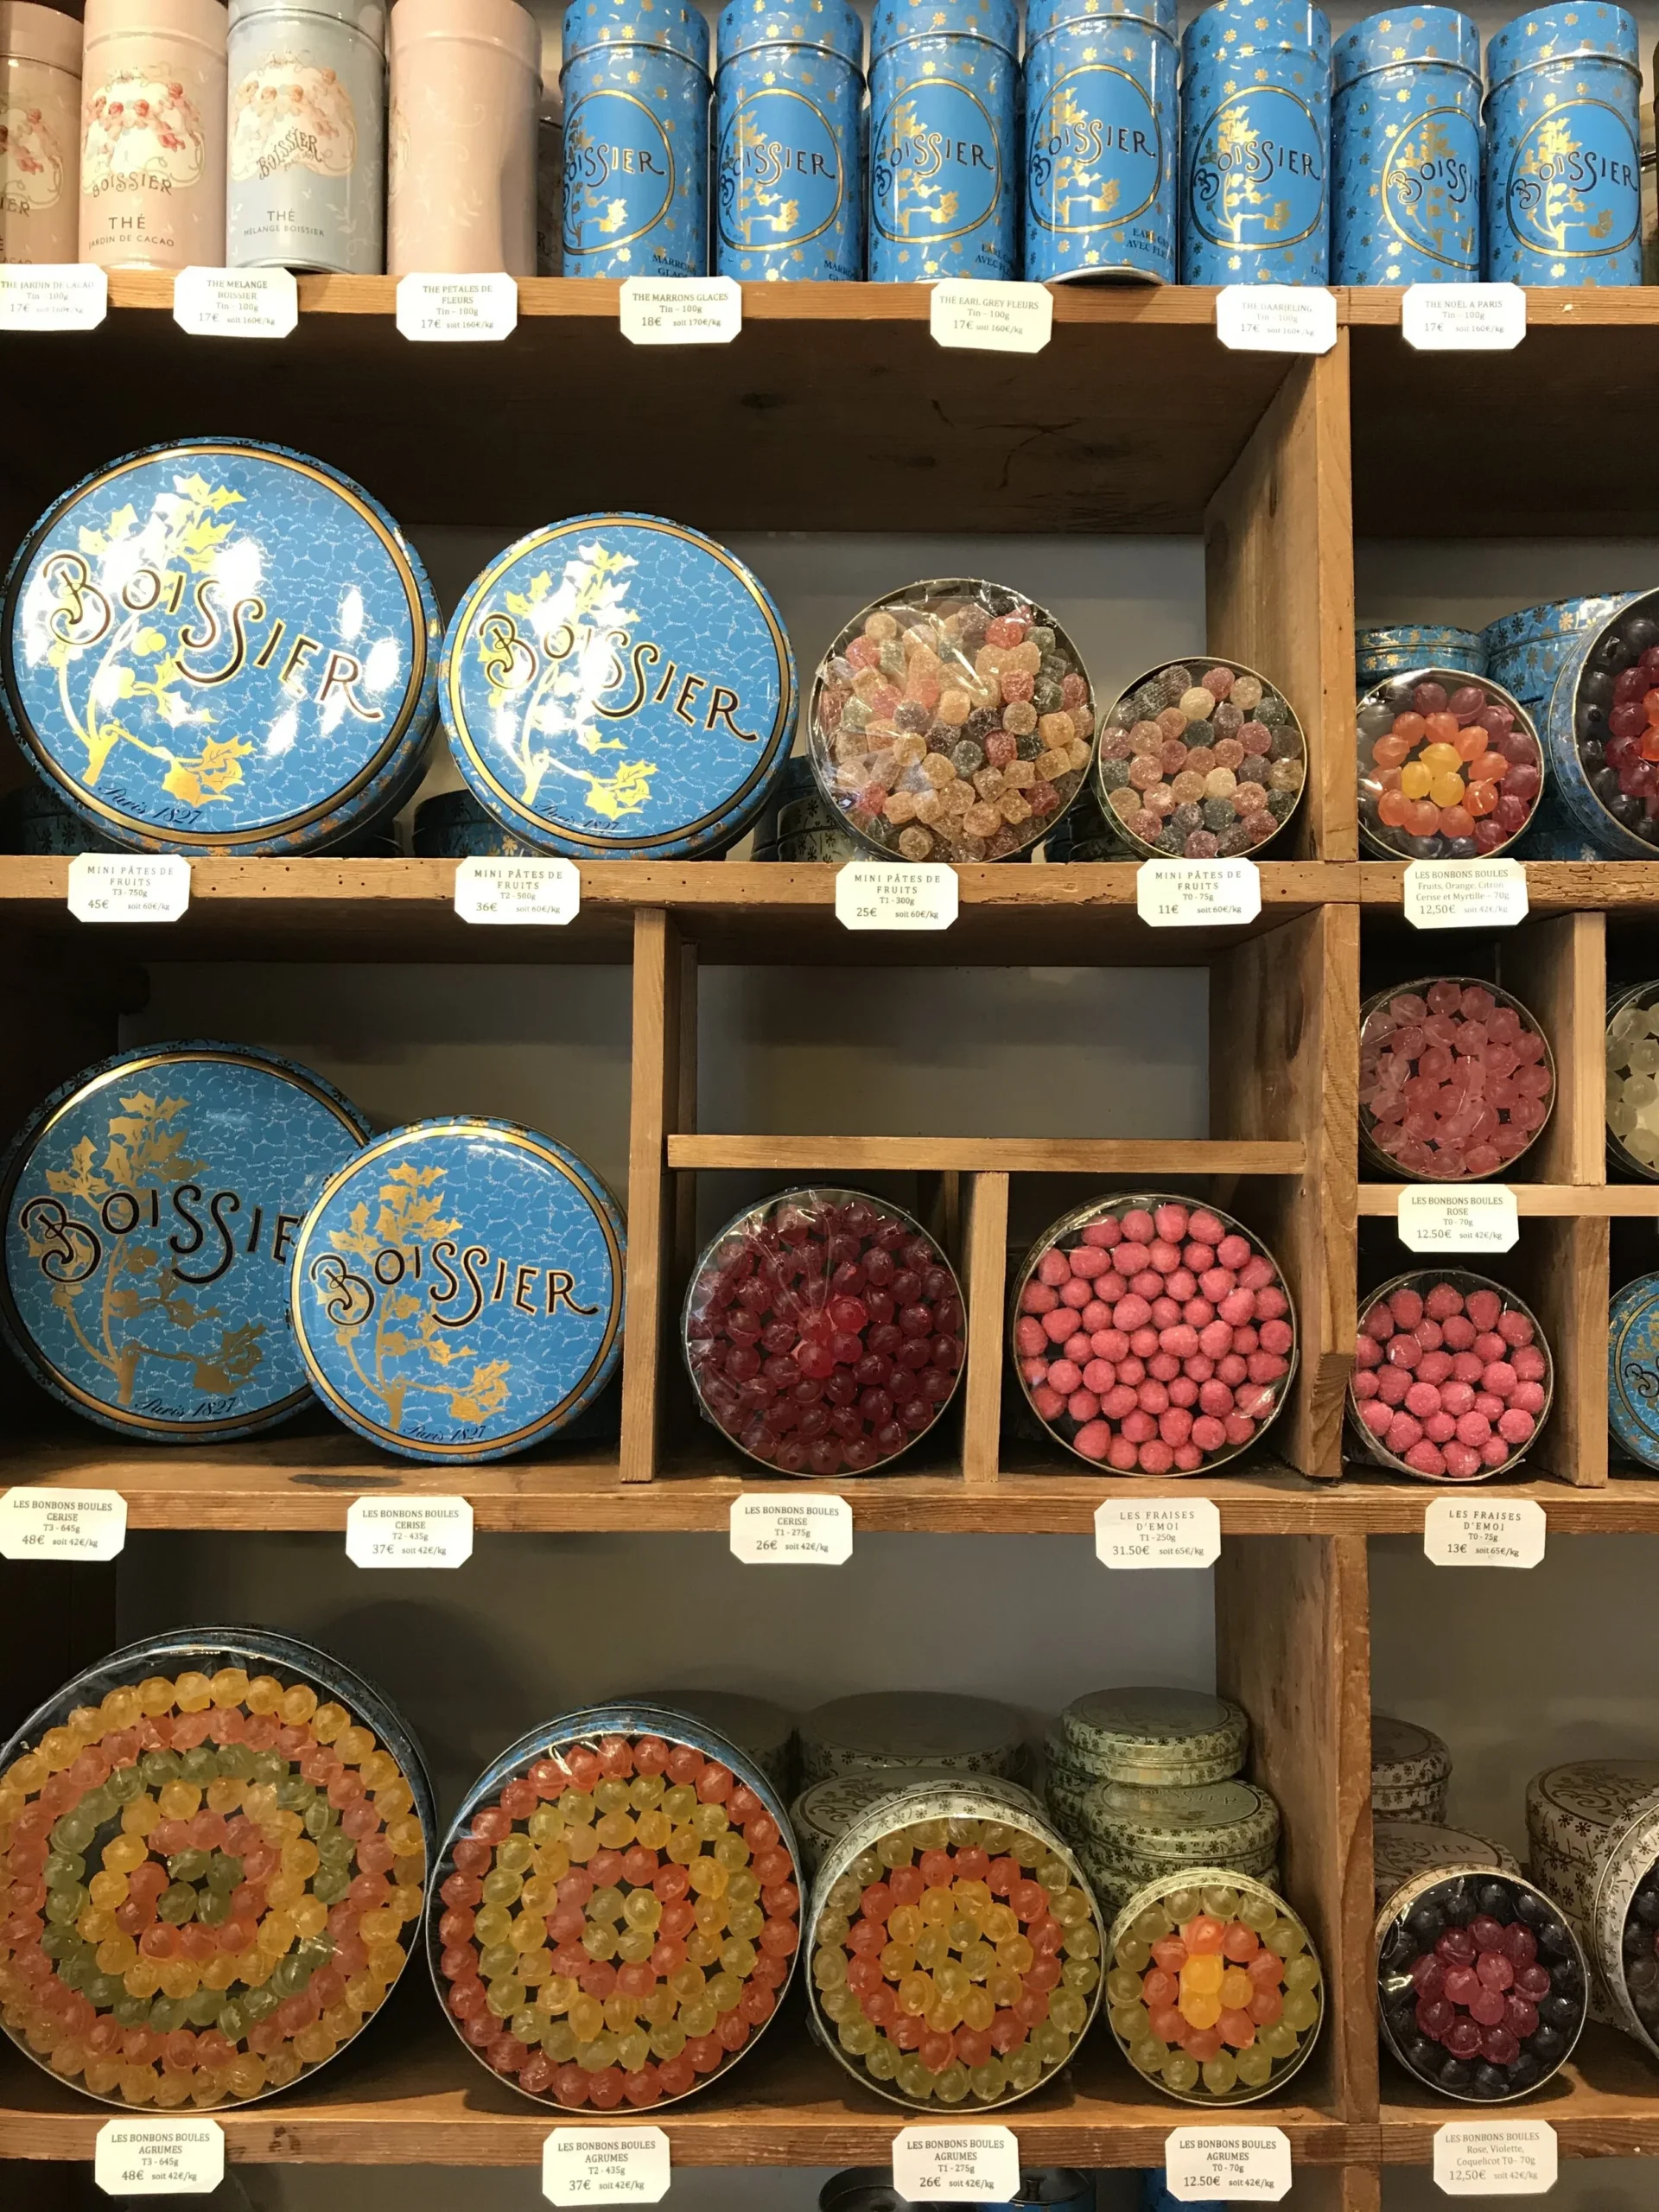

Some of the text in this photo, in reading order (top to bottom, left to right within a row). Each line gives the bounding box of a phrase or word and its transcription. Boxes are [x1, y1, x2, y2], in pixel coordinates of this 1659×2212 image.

[257, 126, 322, 180] BOISSIER
[1031, 120, 1156, 187] BOISSIER
[874, 133, 995, 197] BOISSIER
[1193, 141, 1320, 200] BOISSIER
[92, 172, 172, 197] BOISSIER
[1511, 151, 1637, 209] BOISSIER
[267, 209, 295, 221] THÉ
[109, 214, 146, 229] THÉ
[284, 226, 324, 236] BOISSIER
[89, 236, 115, 250] JARDIN
[137, 235, 175, 246] CACAO
[1127, 240, 1151, 251] AVEC
[1007, 301, 1039, 309] FLEURS
[421, 320, 441, 328] 17€
[642, 317, 661, 326] 18€
[954, 320, 973, 329] 17€
[43, 554, 384, 721] BOISSIER
[480, 614, 758, 742] BOISSIER
[99, 781, 202, 824] Paris 1827
[121, 866, 156, 874] PÂTES
[508, 869, 544, 879] PÂTES
[1188, 870, 1224, 879] PÂTES
[887, 874, 922, 882] PÂTES
[1453, 893, 1484, 901] Myrtille
[88, 899, 109, 909] 45€
[476, 903, 498, 912] 36€
[1159, 905, 1179, 913] 11€
[857, 908, 877, 917] 25€
[1420, 905, 1456, 915] 12,50€
[20, 1185, 299, 1284] BOISSIE
[1417, 1230, 1452, 1238] 12.50€
[311, 1242, 599, 1327] BOISSIER
[135, 1395, 236, 1418] Paris 1827
[402, 1425, 486, 1441] Paris 1827
[32, 1501, 75, 1510] BONBONS
[78, 1503, 112, 1511] BOULES
[1474, 1511, 1521, 1521] FRAISES
[1464, 1522, 1503, 1531] D'EMOI
[22, 1535, 45, 1545] 48€
[372, 1545, 394, 1554] 37€
[756, 1541, 777, 1550] 26€
[801, 1543, 829, 1552] 42€/kg
[1113, 1546, 1149, 1555] 31.50€
[1447, 1544, 1467, 1553] 13€
[112, 2134, 128, 2143] LES
[970, 2139, 1004, 2148] BOULES
[558, 2143, 574, 2152] LES
[576, 2142, 619, 2151] BONBONS
[1243, 2140, 1276, 2149] BOULES
[1491, 2145, 1524, 2153] Violette,
[585, 2153, 628, 2163] AGRUMES
[1457, 2158, 1500, 2167] Coquelicot
[122, 2171, 143, 2180] 48€
[1450, 2171, 1486, 2181] 12,50€
[569, 2180, 591, 2190] 37€
[920, 2177, 941, 2187] 26€
[1184, 2177, 1220, 2186] 12.50€
